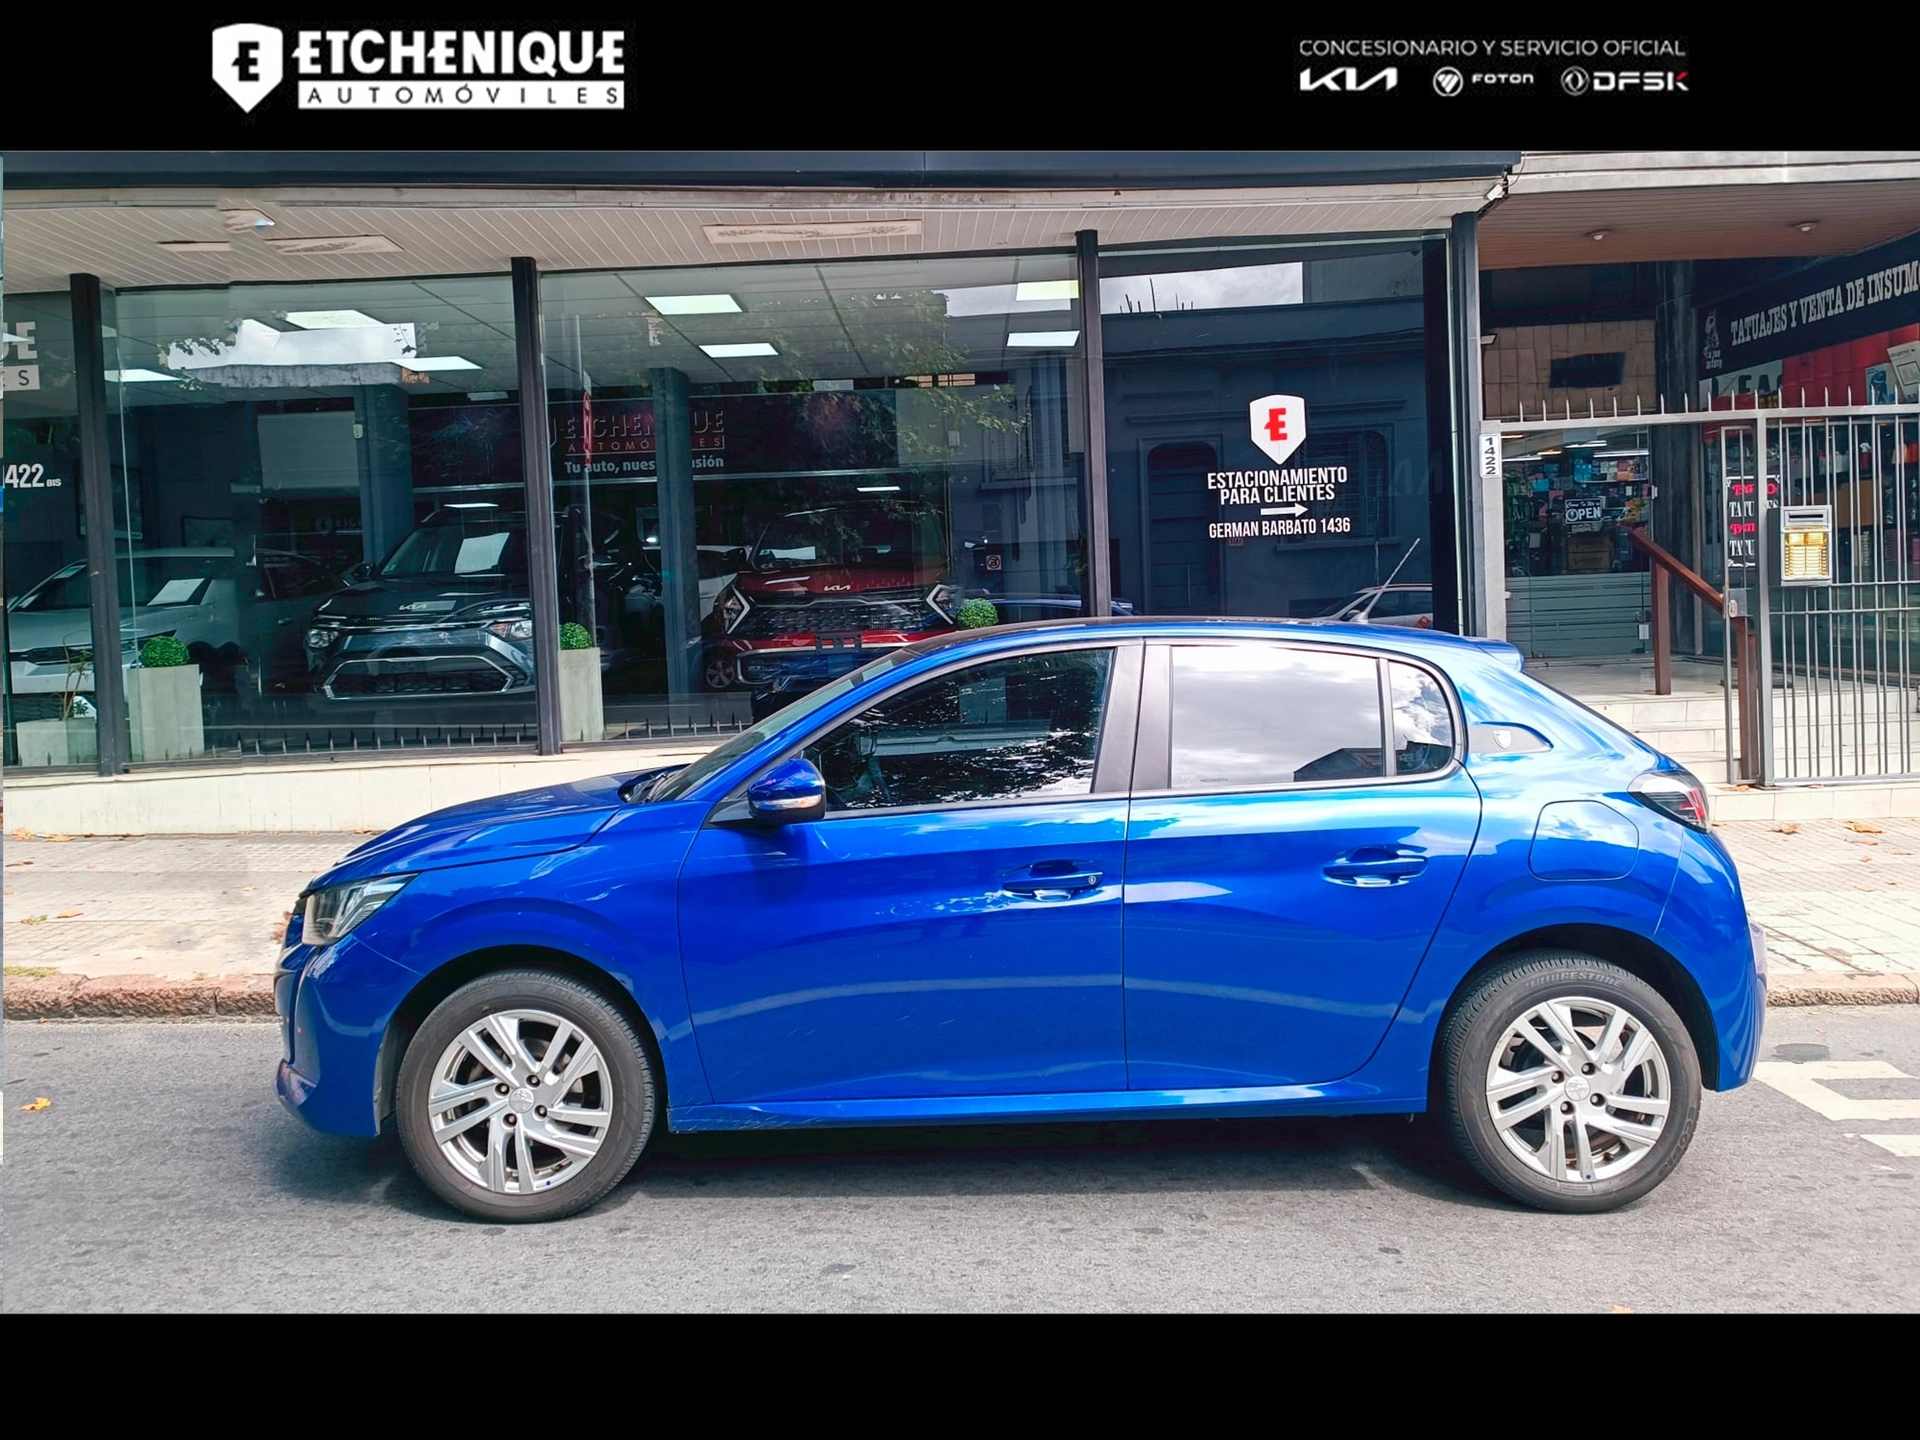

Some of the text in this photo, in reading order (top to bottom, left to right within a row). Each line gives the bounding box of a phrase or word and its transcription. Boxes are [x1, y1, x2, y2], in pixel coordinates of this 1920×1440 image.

[1730, 260, 1920, 346] TATUAJES Y VENTA DE INSUM
[565, 455, 724, 474] Tu auto, nues sión
[1484, 437, 1496, 475] 1422
[3, 463, 62, 488] 422 BIS
[1207, 466, 1348, 490] ESTACIONAMIENTO
[1220, 483, 1335, 505] PARA CLIENTES
[1566, 506, 1601, 521] OPEN
[1209, 517, 1351, 539] GERMAN BARBATO 1436
